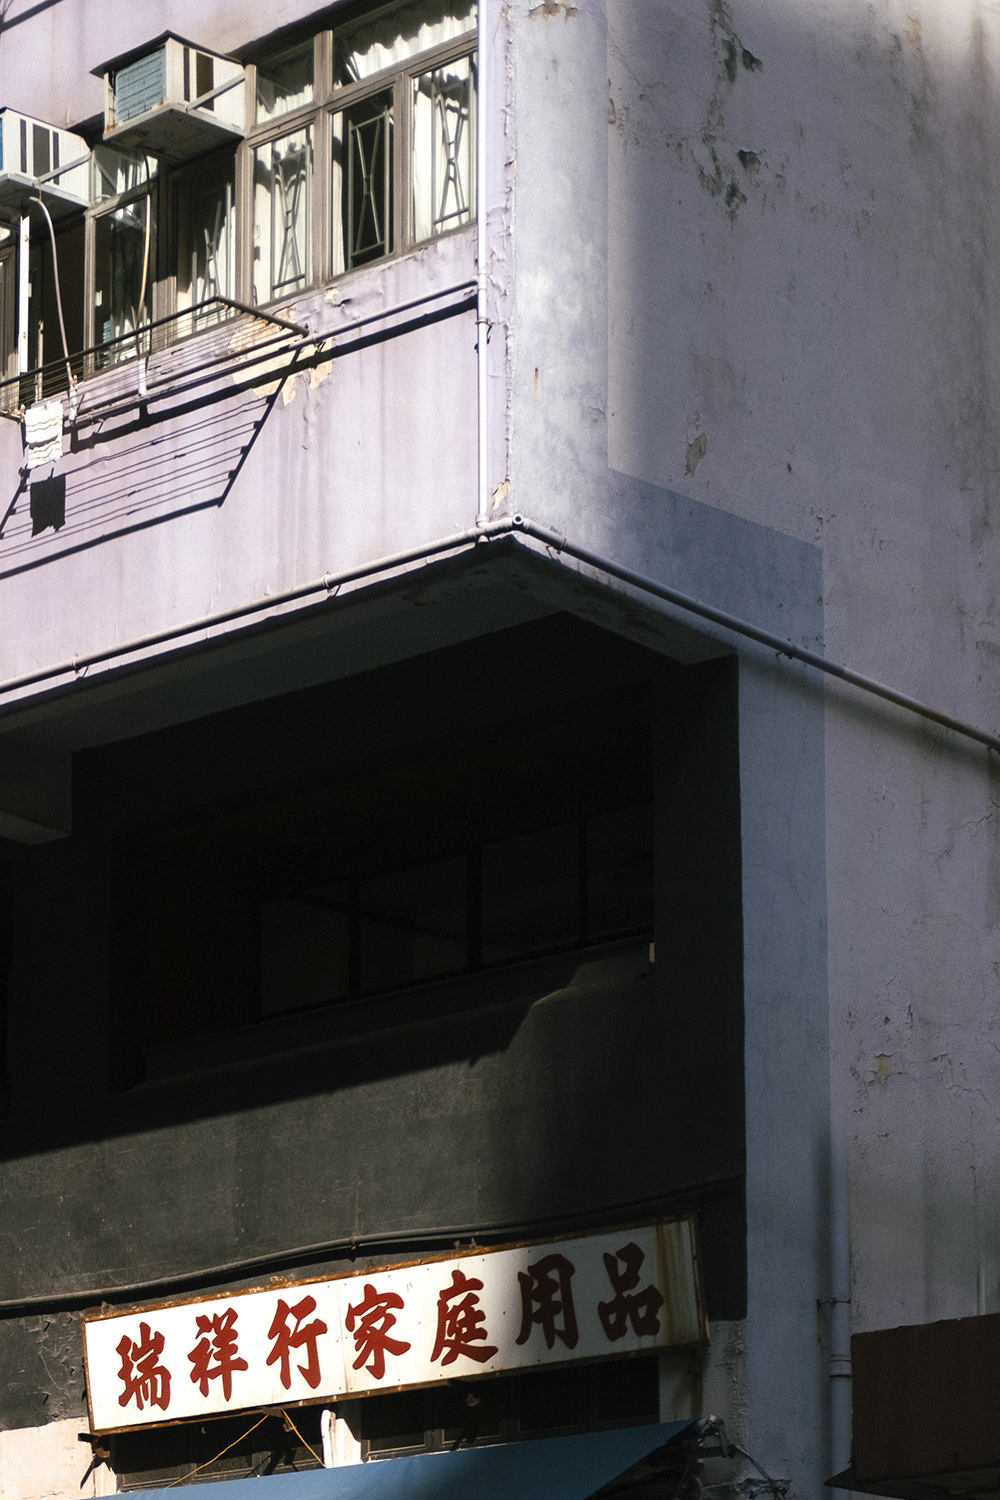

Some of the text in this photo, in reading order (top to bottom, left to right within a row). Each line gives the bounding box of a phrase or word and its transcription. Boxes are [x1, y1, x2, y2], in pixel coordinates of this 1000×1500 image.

[115, 1242, 664, 1411] 瑞祥行家庭用品
